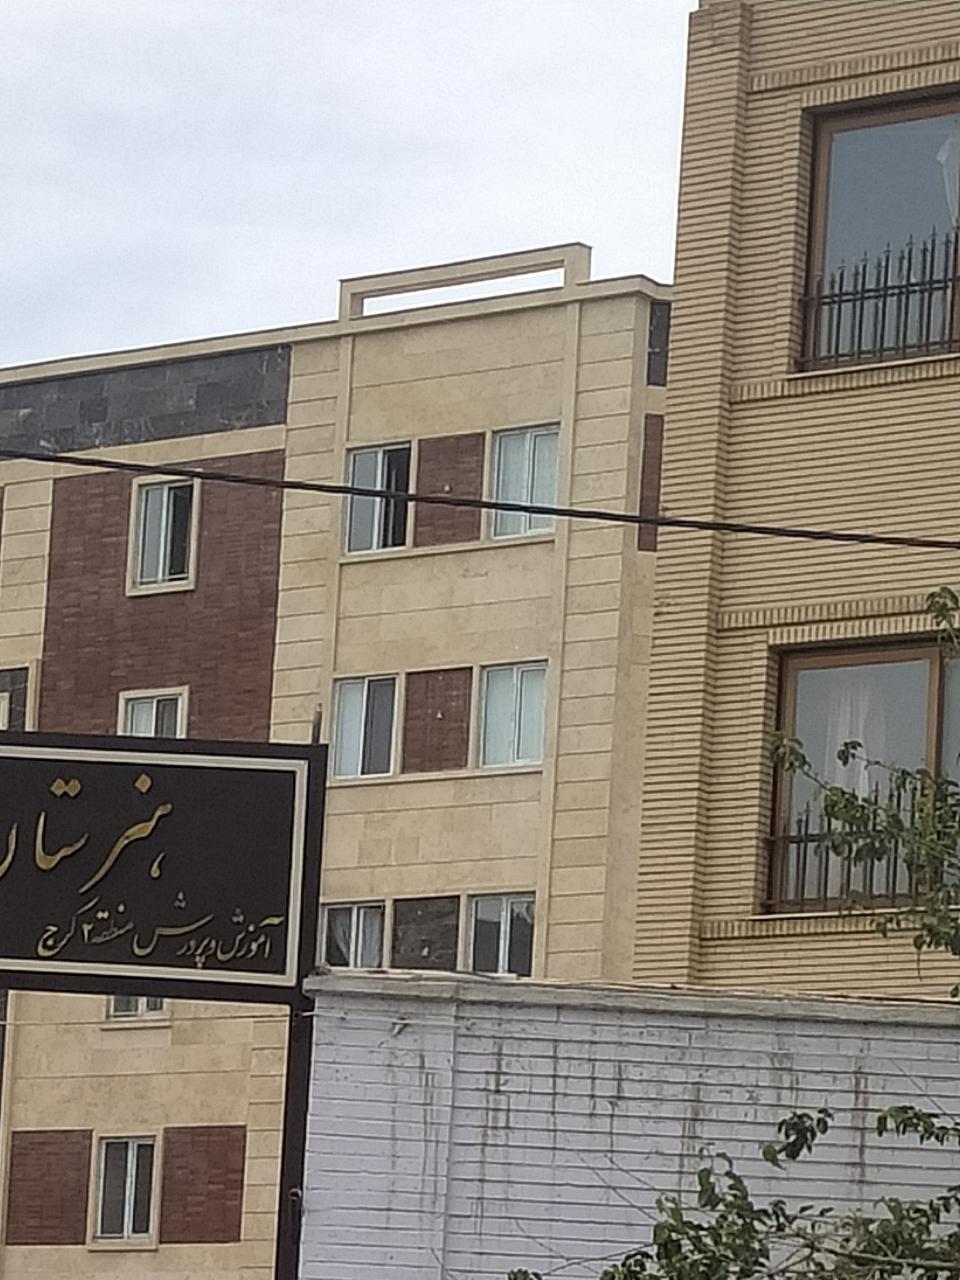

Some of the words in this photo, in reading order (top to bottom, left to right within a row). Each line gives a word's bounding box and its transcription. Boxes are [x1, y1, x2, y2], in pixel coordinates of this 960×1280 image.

[37, 896, 100, 957] کرج
[132, 891, 214, 969] پرورش
[216, 908, 285, 962] آموزش
